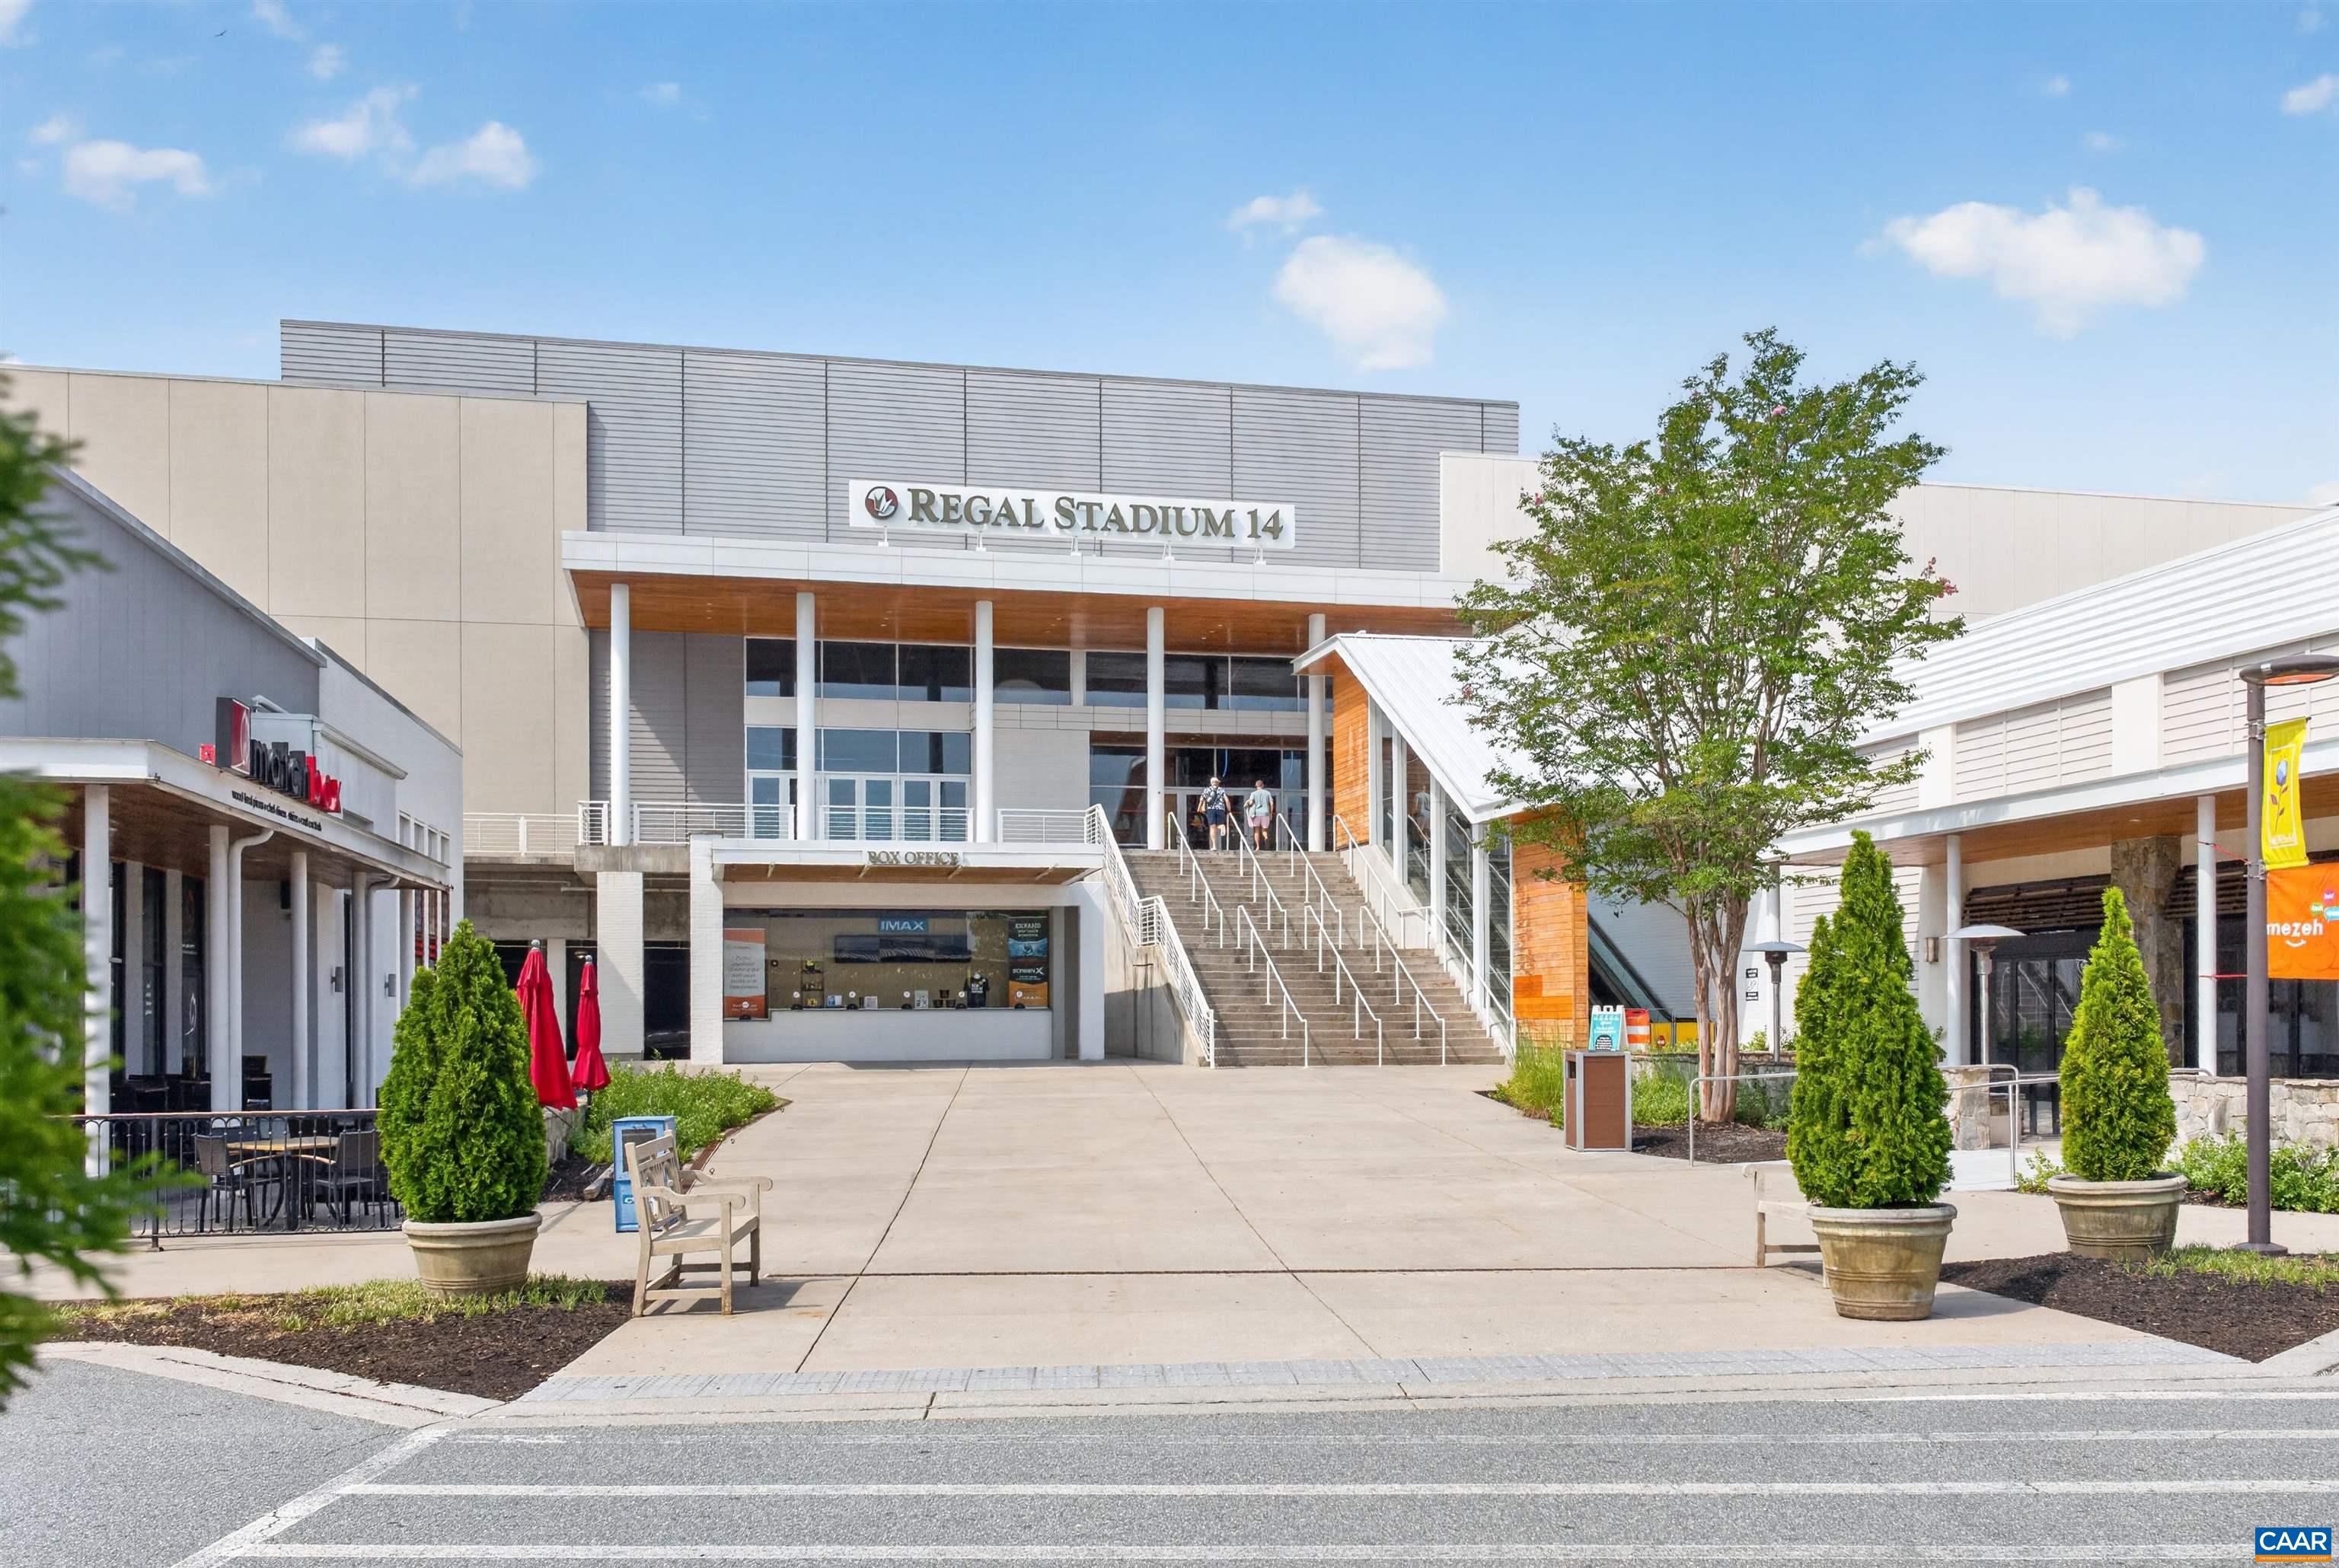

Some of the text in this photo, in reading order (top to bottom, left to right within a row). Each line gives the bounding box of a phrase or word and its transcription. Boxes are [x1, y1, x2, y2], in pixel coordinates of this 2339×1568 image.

[908, 488, 1284, 540] REGAL STADIUM 14
[867, 850, 959, 865] BOX OFFICE
[881, 920, 924, 931] IMAX
[2266, 917, 2324, 938] mezeh
